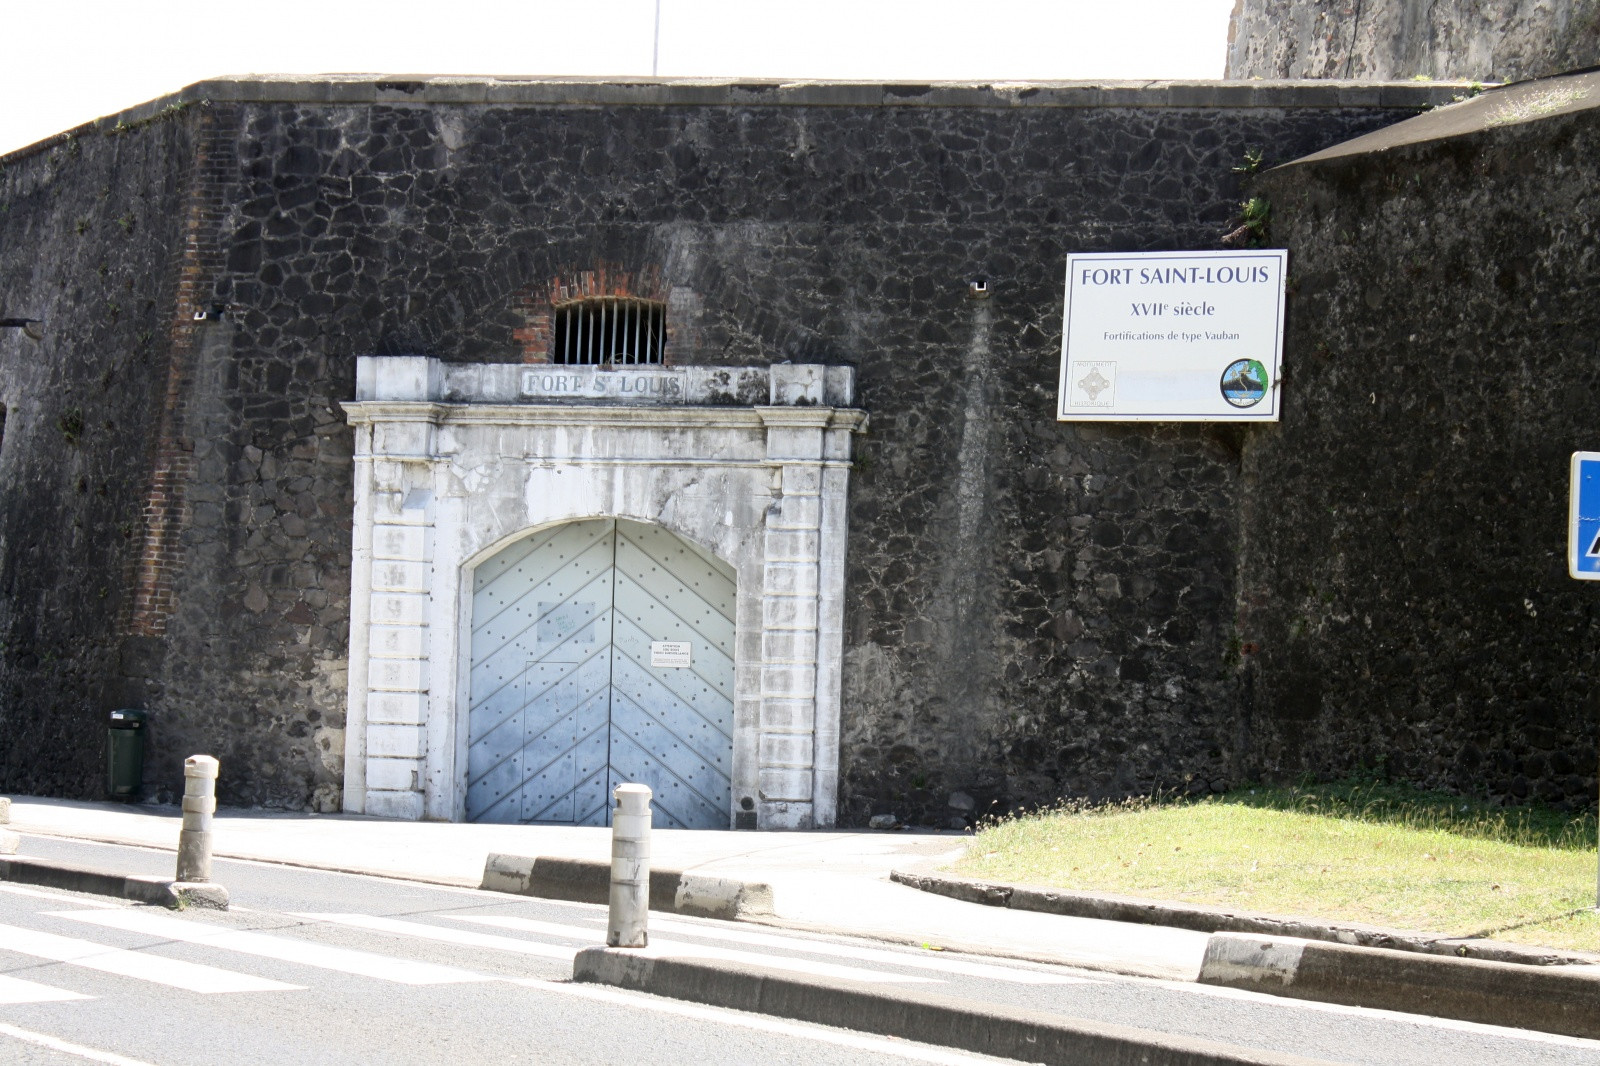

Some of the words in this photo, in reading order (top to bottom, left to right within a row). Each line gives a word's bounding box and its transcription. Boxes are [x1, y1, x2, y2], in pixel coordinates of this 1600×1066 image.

[1082, 268, 1134, 285] FORT
[1140, 266, 1269, 285] SAINT-LOUIS
[1173, 301, 1215, 316] siècle
[1103, 331, 1165, 341] Fortifications
[1167, 330, 1179, 341] de
[1181, 331, 1202, 343] type
[1205, 330, 1240, 341] Vauban
[527, 375, 583, 392] FORT
[620, 376, 681, 396] LOUIS
